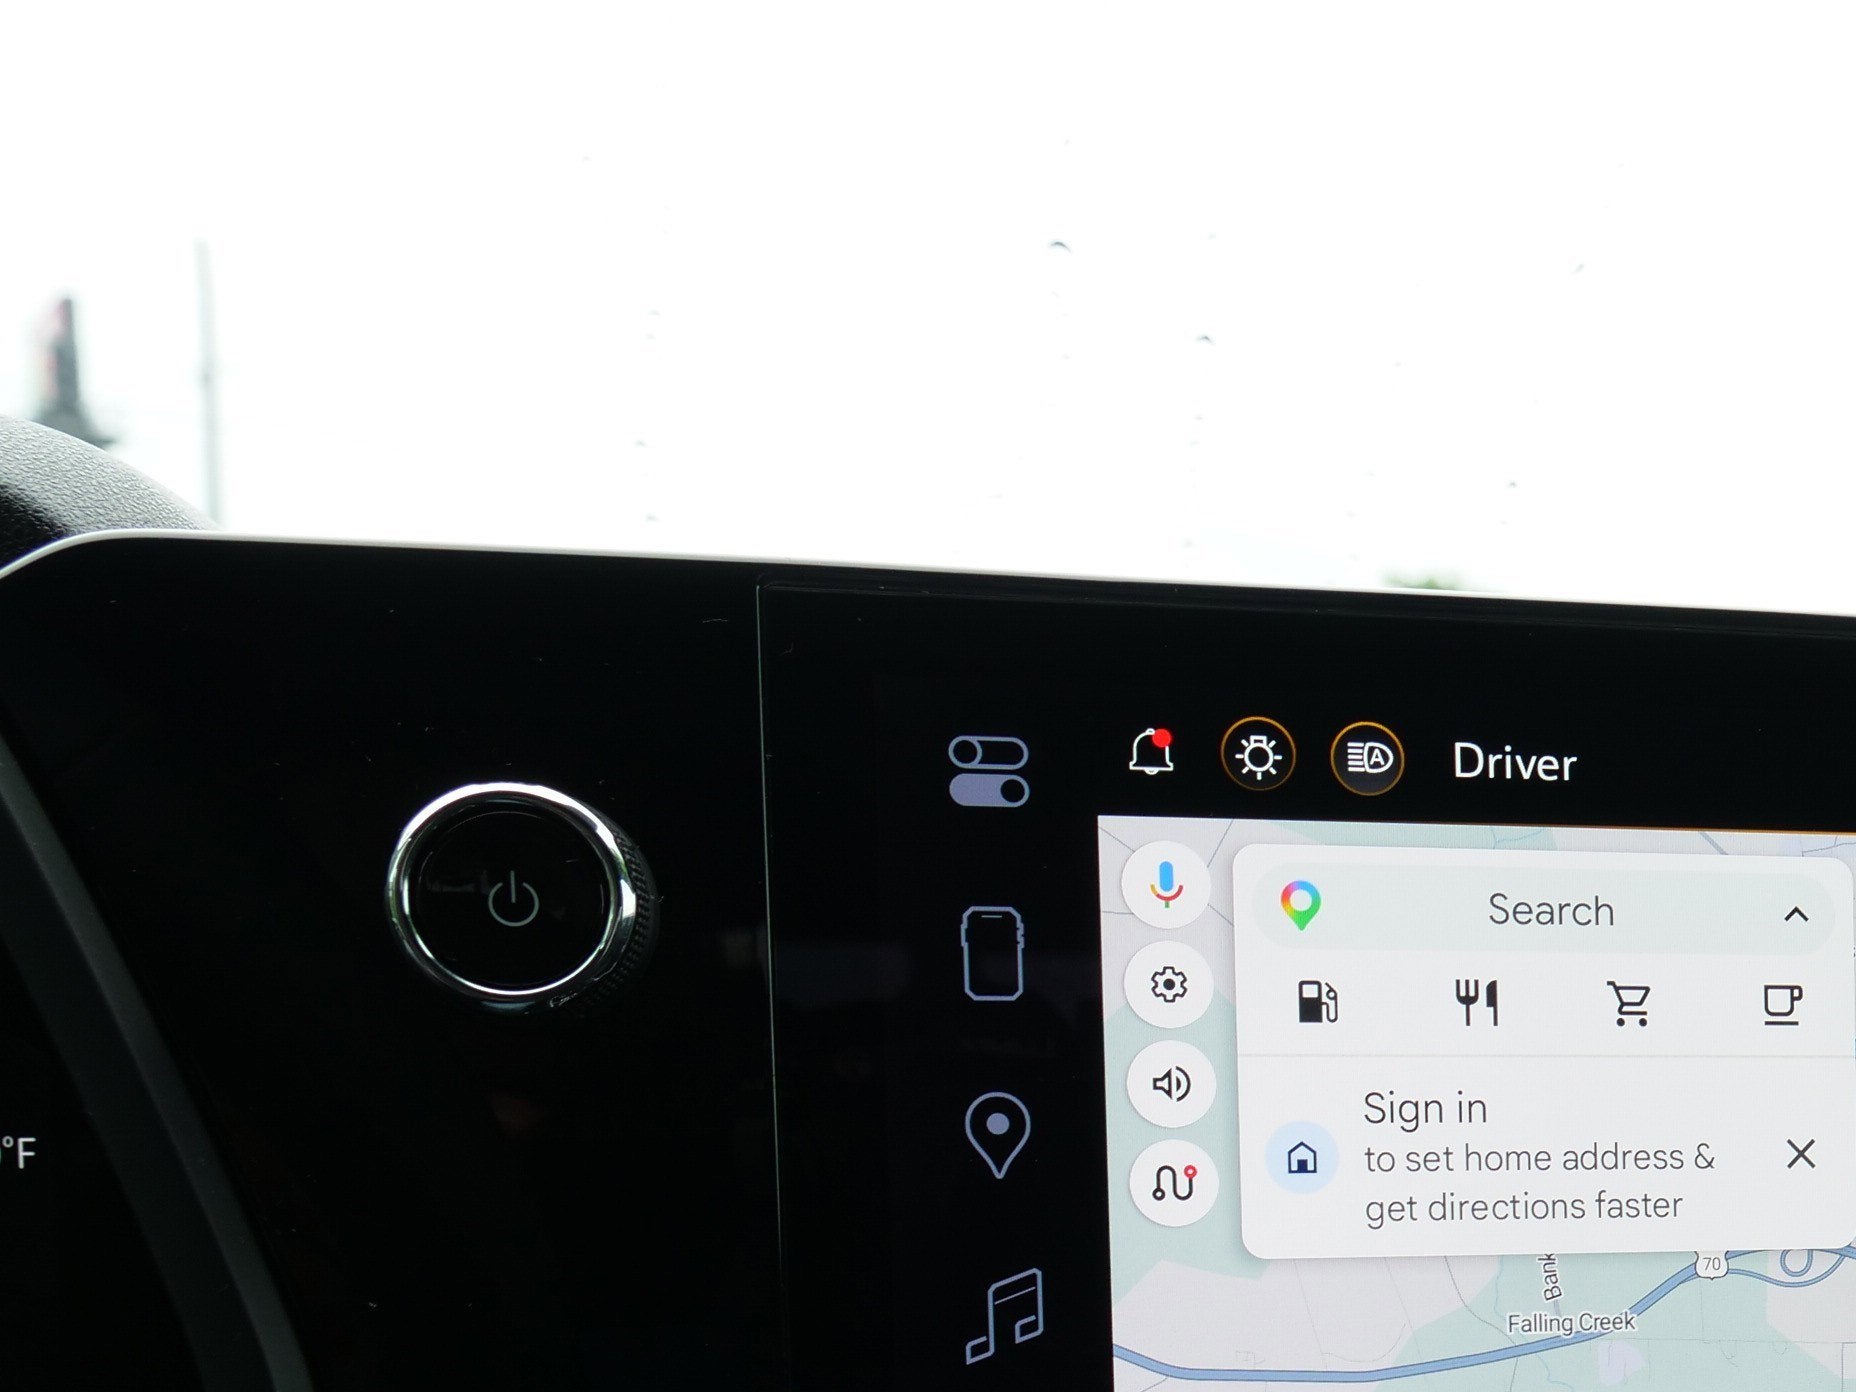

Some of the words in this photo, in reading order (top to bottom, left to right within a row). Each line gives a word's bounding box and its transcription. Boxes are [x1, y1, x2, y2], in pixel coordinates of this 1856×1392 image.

[1454, 741, 1578, 782] Driver
[1488, 892, 1614, 927] Search
[1363, 1089, 1444, 1133] Sign
[1457, 1089, 1488, 1123] in
[0, 1134, 37, 1170] °F
[1364, 1146, 1396, 1172] to
[1405, 1146, 1455, 1172] set
[1465, 1142, 1552, 1172] home
[1562, 1141, 1685, 1171] address
[1694, 1142, 1716, 1171] &
[1365, 1195, 1418, 1230] get
[1428, 1191, 1586, 1222] directions
[1595, 1189, 1684, 1219] faster
[1702, 1257, 1721, 1271] 70
[1508, 1313, 1574, 1337] Falling
[1579, 1311, 1636, 1331] Creek
